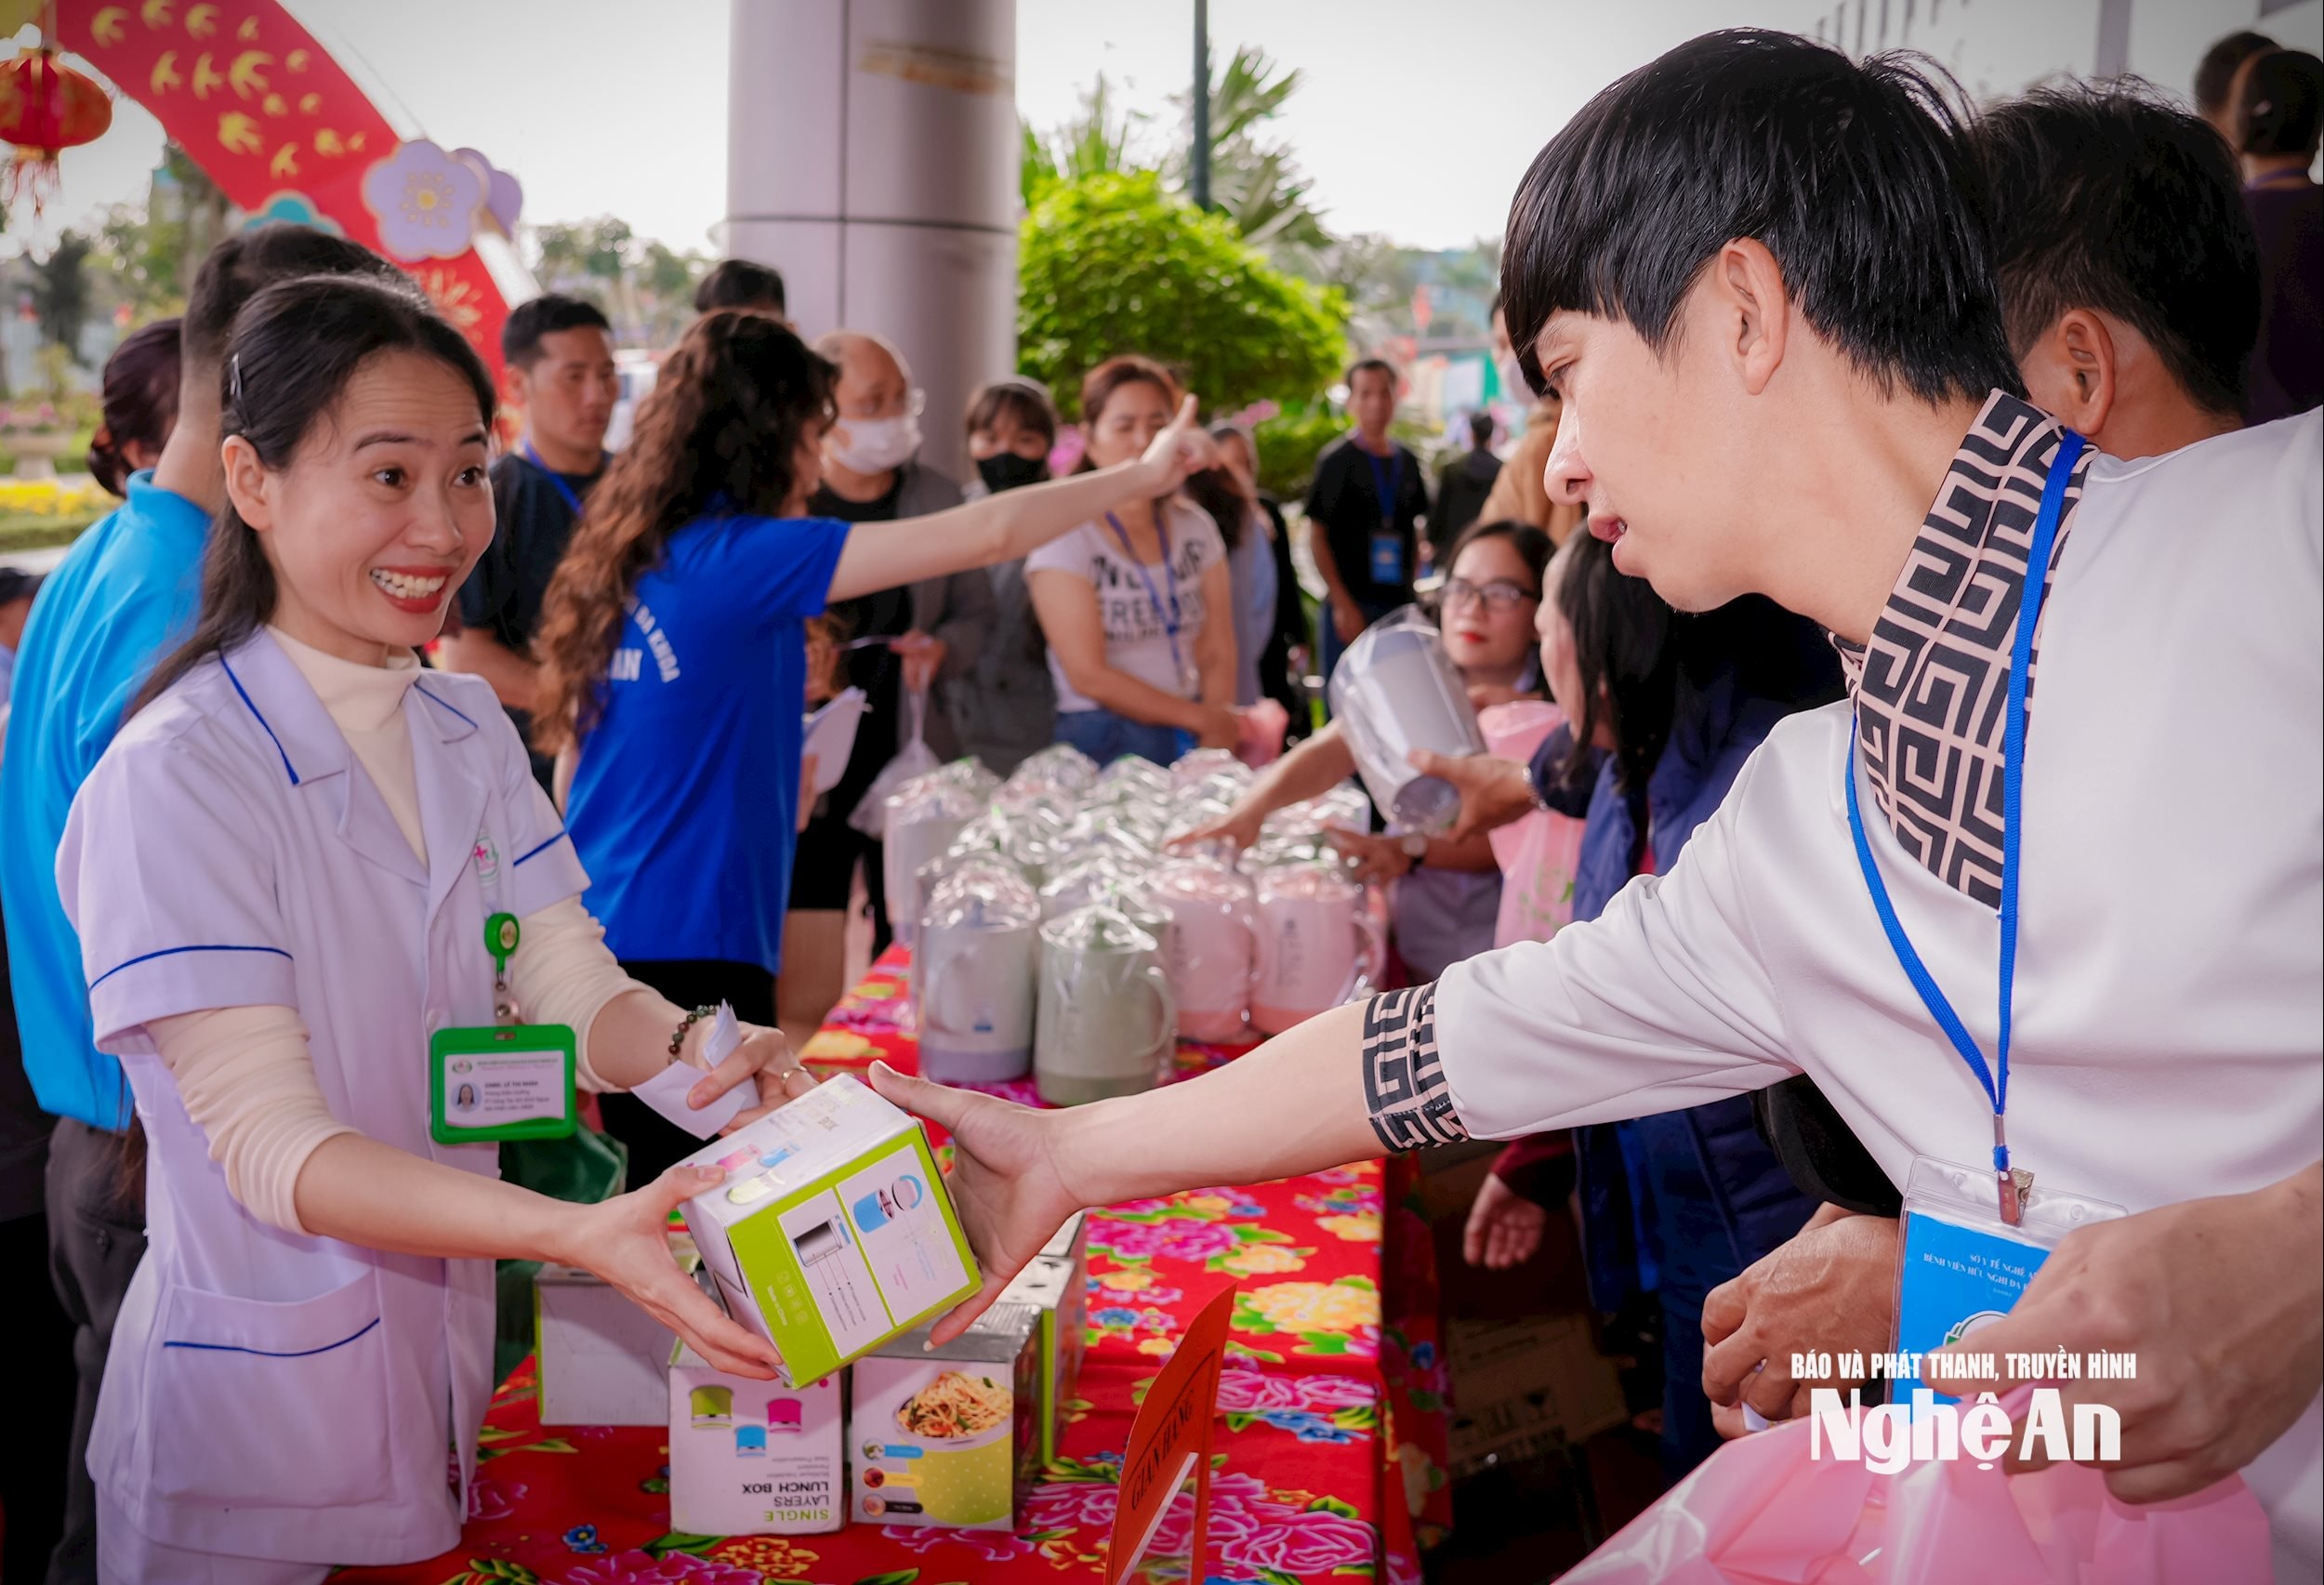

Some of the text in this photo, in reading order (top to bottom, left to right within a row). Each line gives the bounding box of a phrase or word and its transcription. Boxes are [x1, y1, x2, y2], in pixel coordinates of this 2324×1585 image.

[742, 1481, 829, 1494] LUNCH BOX
[774, 1494, 829, 1507] LAYERS
[765, 1509, 829, 1522] SINGLE
